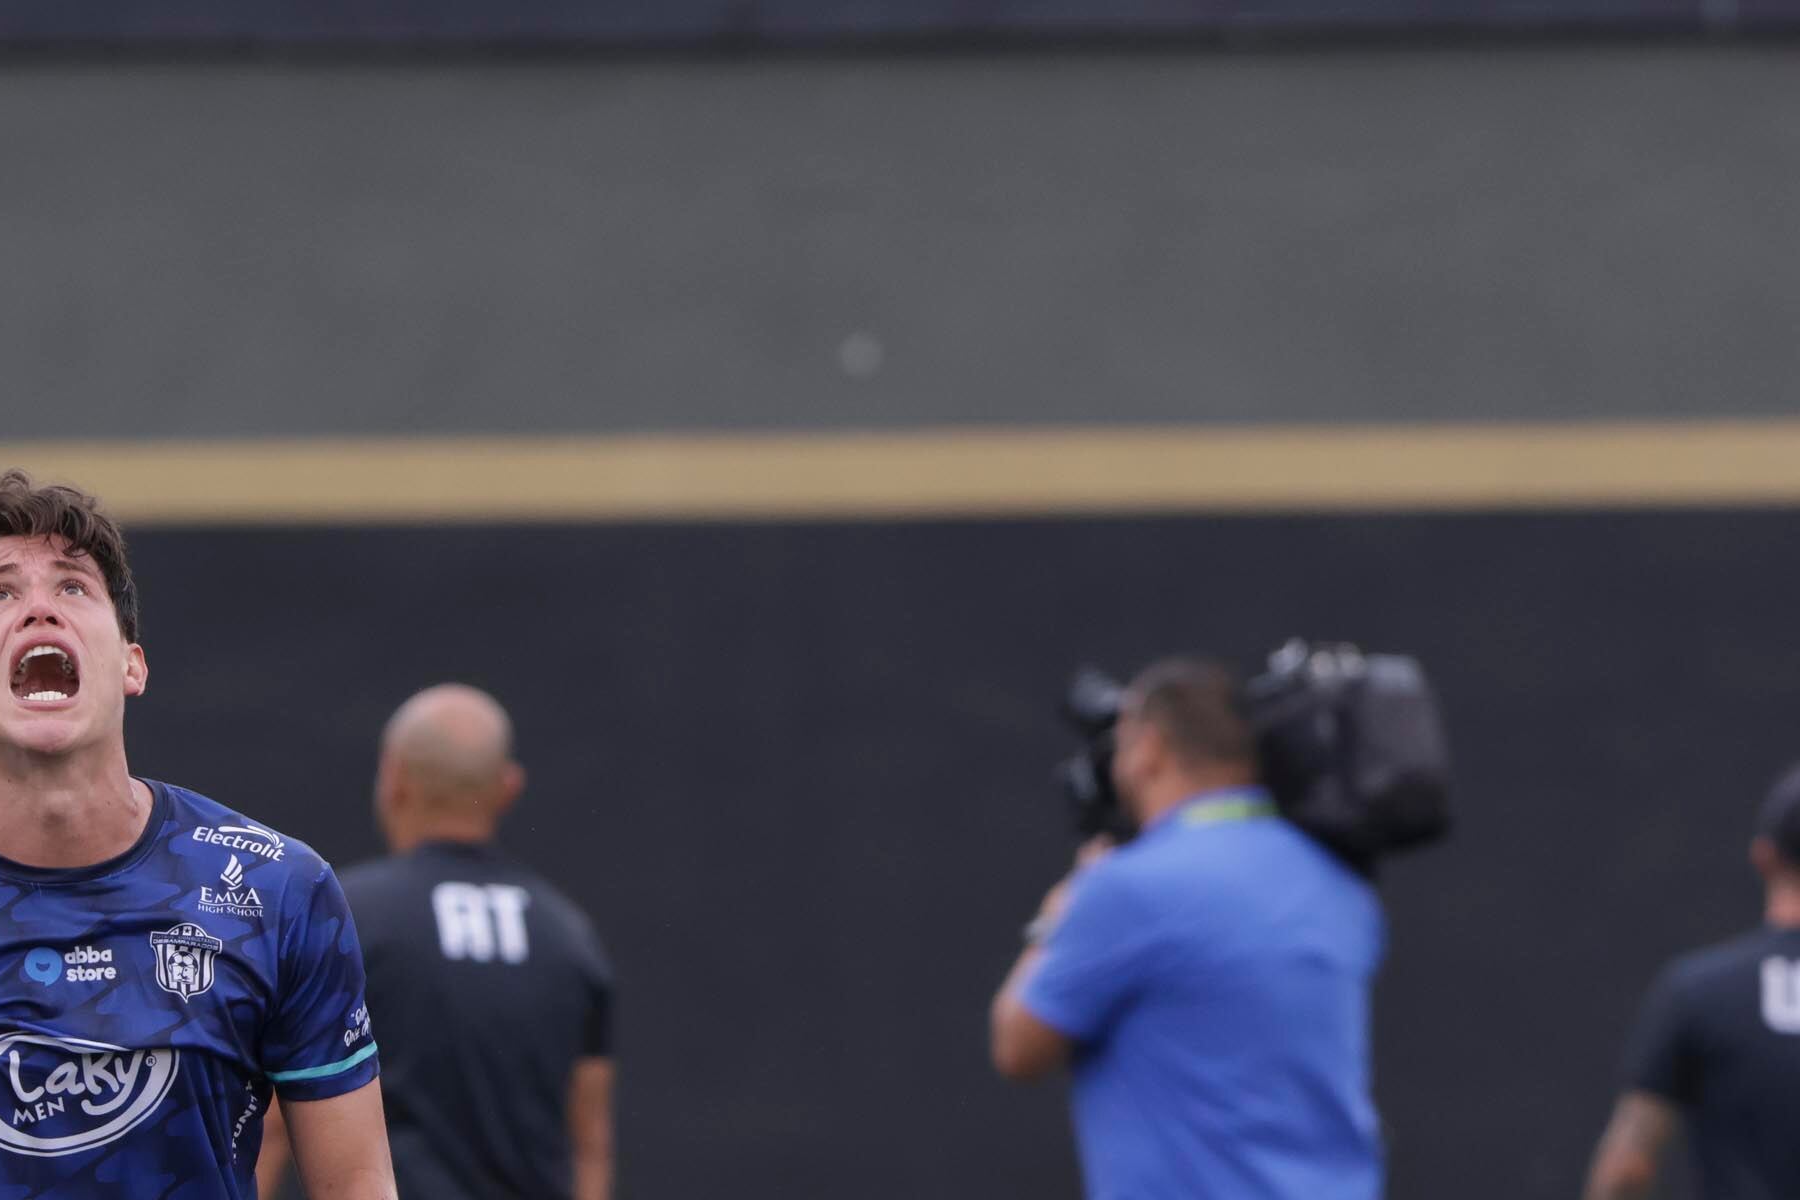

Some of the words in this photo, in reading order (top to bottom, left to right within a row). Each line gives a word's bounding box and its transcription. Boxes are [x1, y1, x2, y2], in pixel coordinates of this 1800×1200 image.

[192, 826, 285, 862] Electrolit
[197, 903, 224, 914] HIGH
[226, 905, 264, 917] SCHOOL
[64, 946, 113, 965] abba
[66, 964, 117, 982] store
[13, 1097, 66, 1125] MEN
